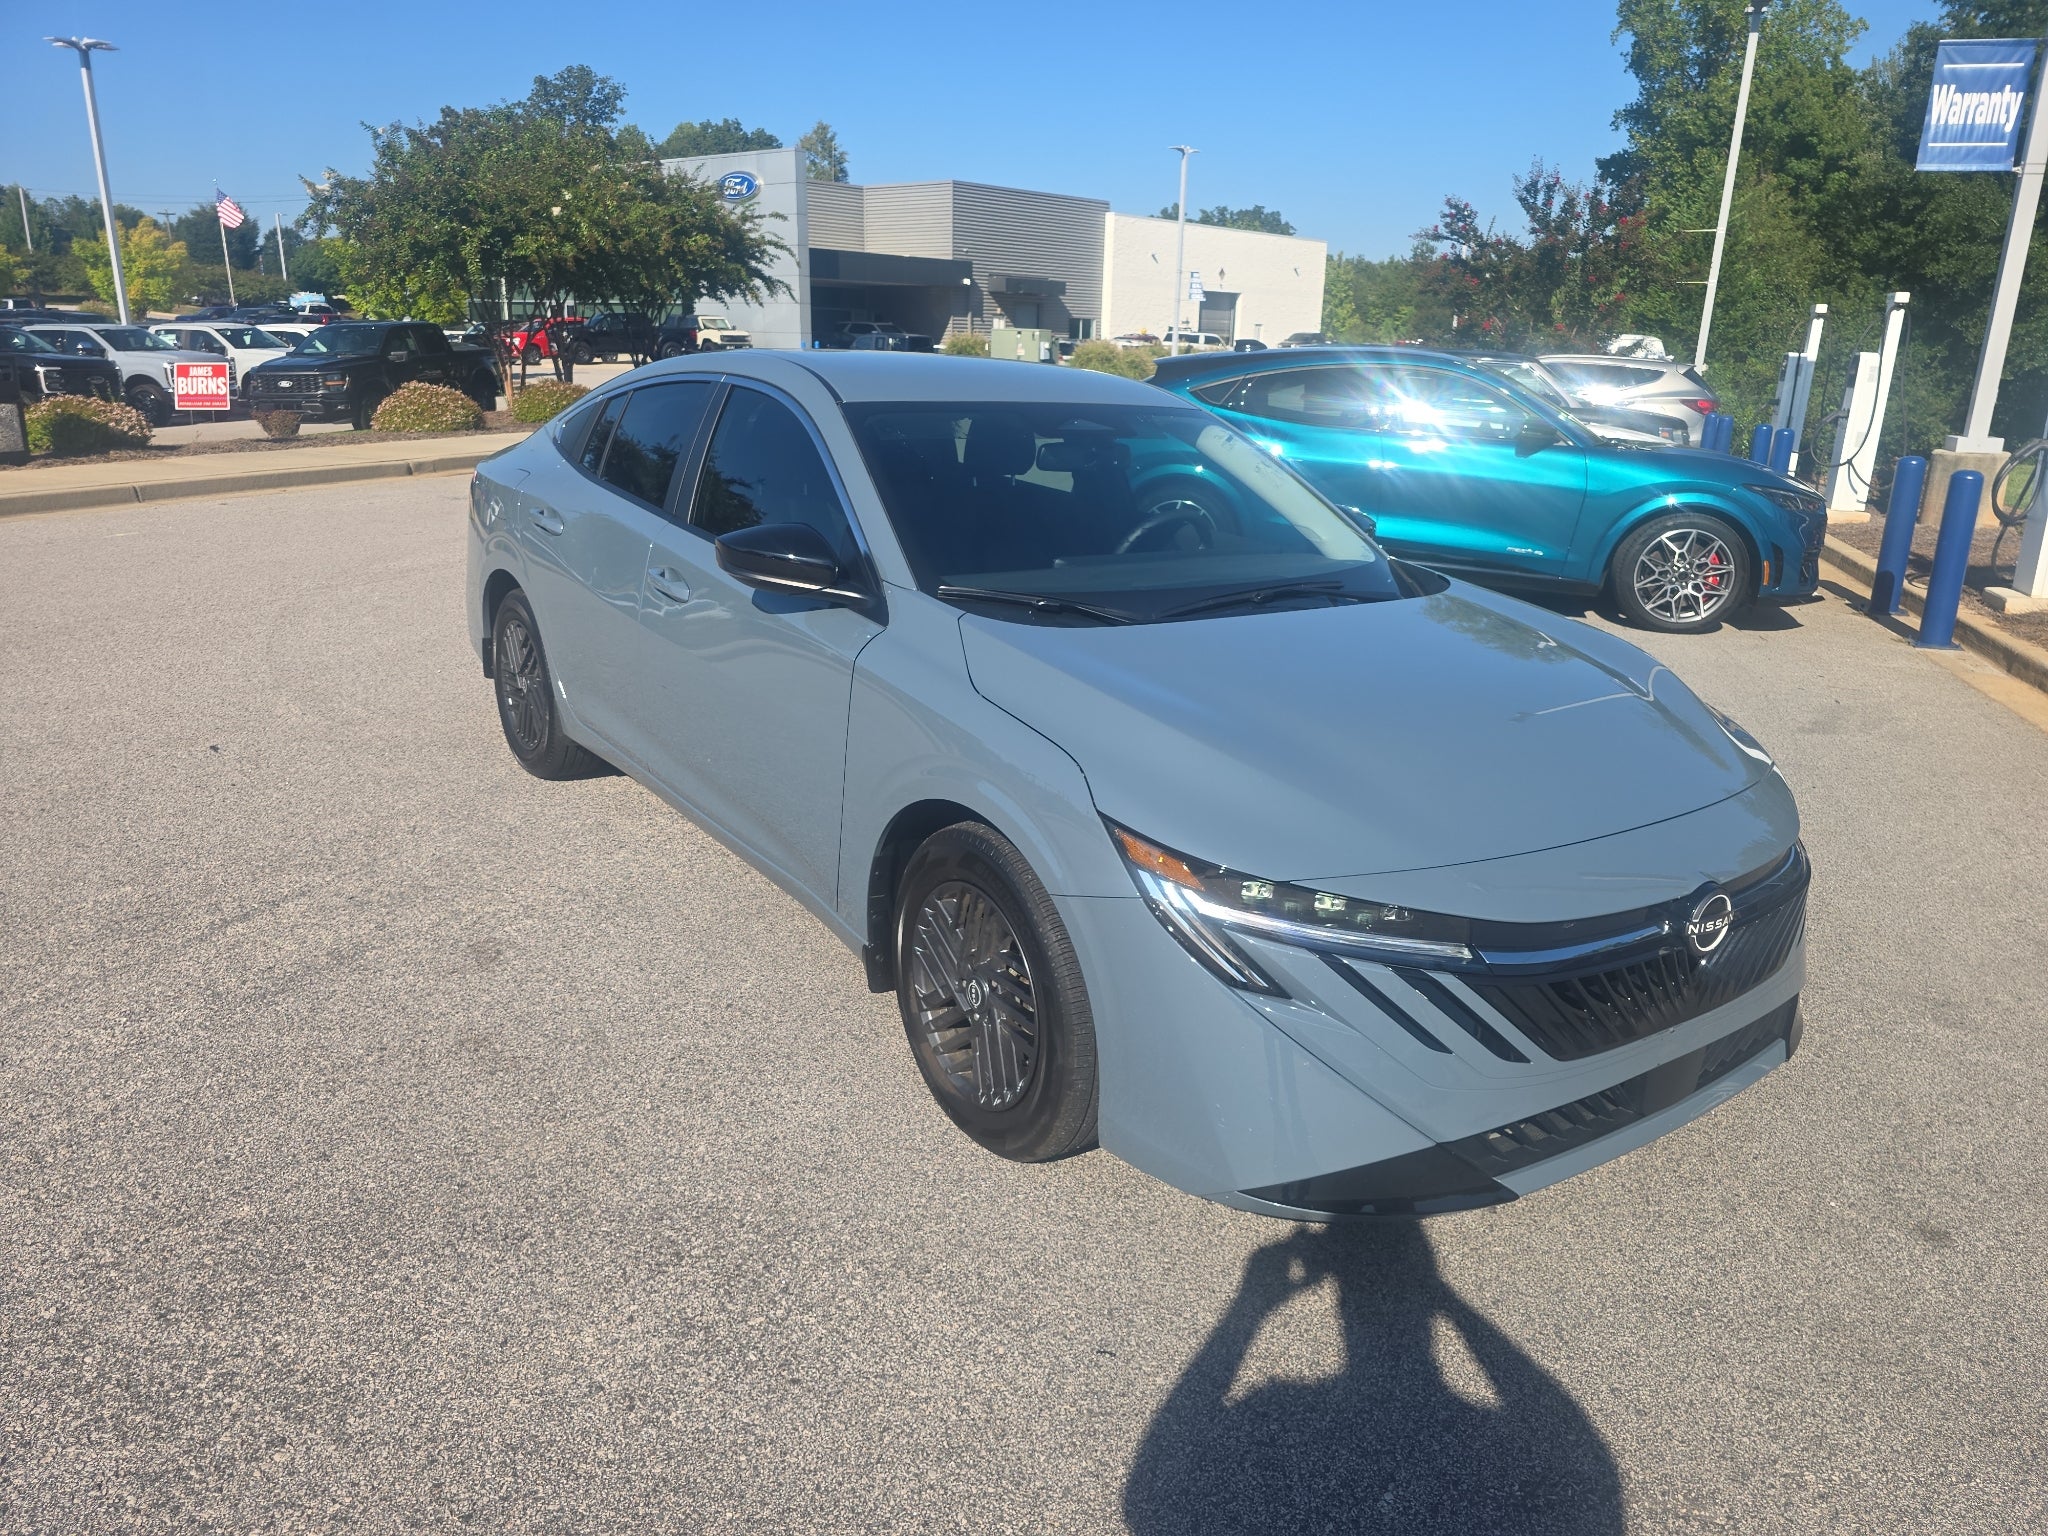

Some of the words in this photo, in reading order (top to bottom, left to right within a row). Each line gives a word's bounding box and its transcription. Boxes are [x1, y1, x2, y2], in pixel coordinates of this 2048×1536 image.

[1931, 84, 2024, 133] Warranty
[189, 366, 213, 377] JAMES
[178, 376, 227, 395] BURNS
